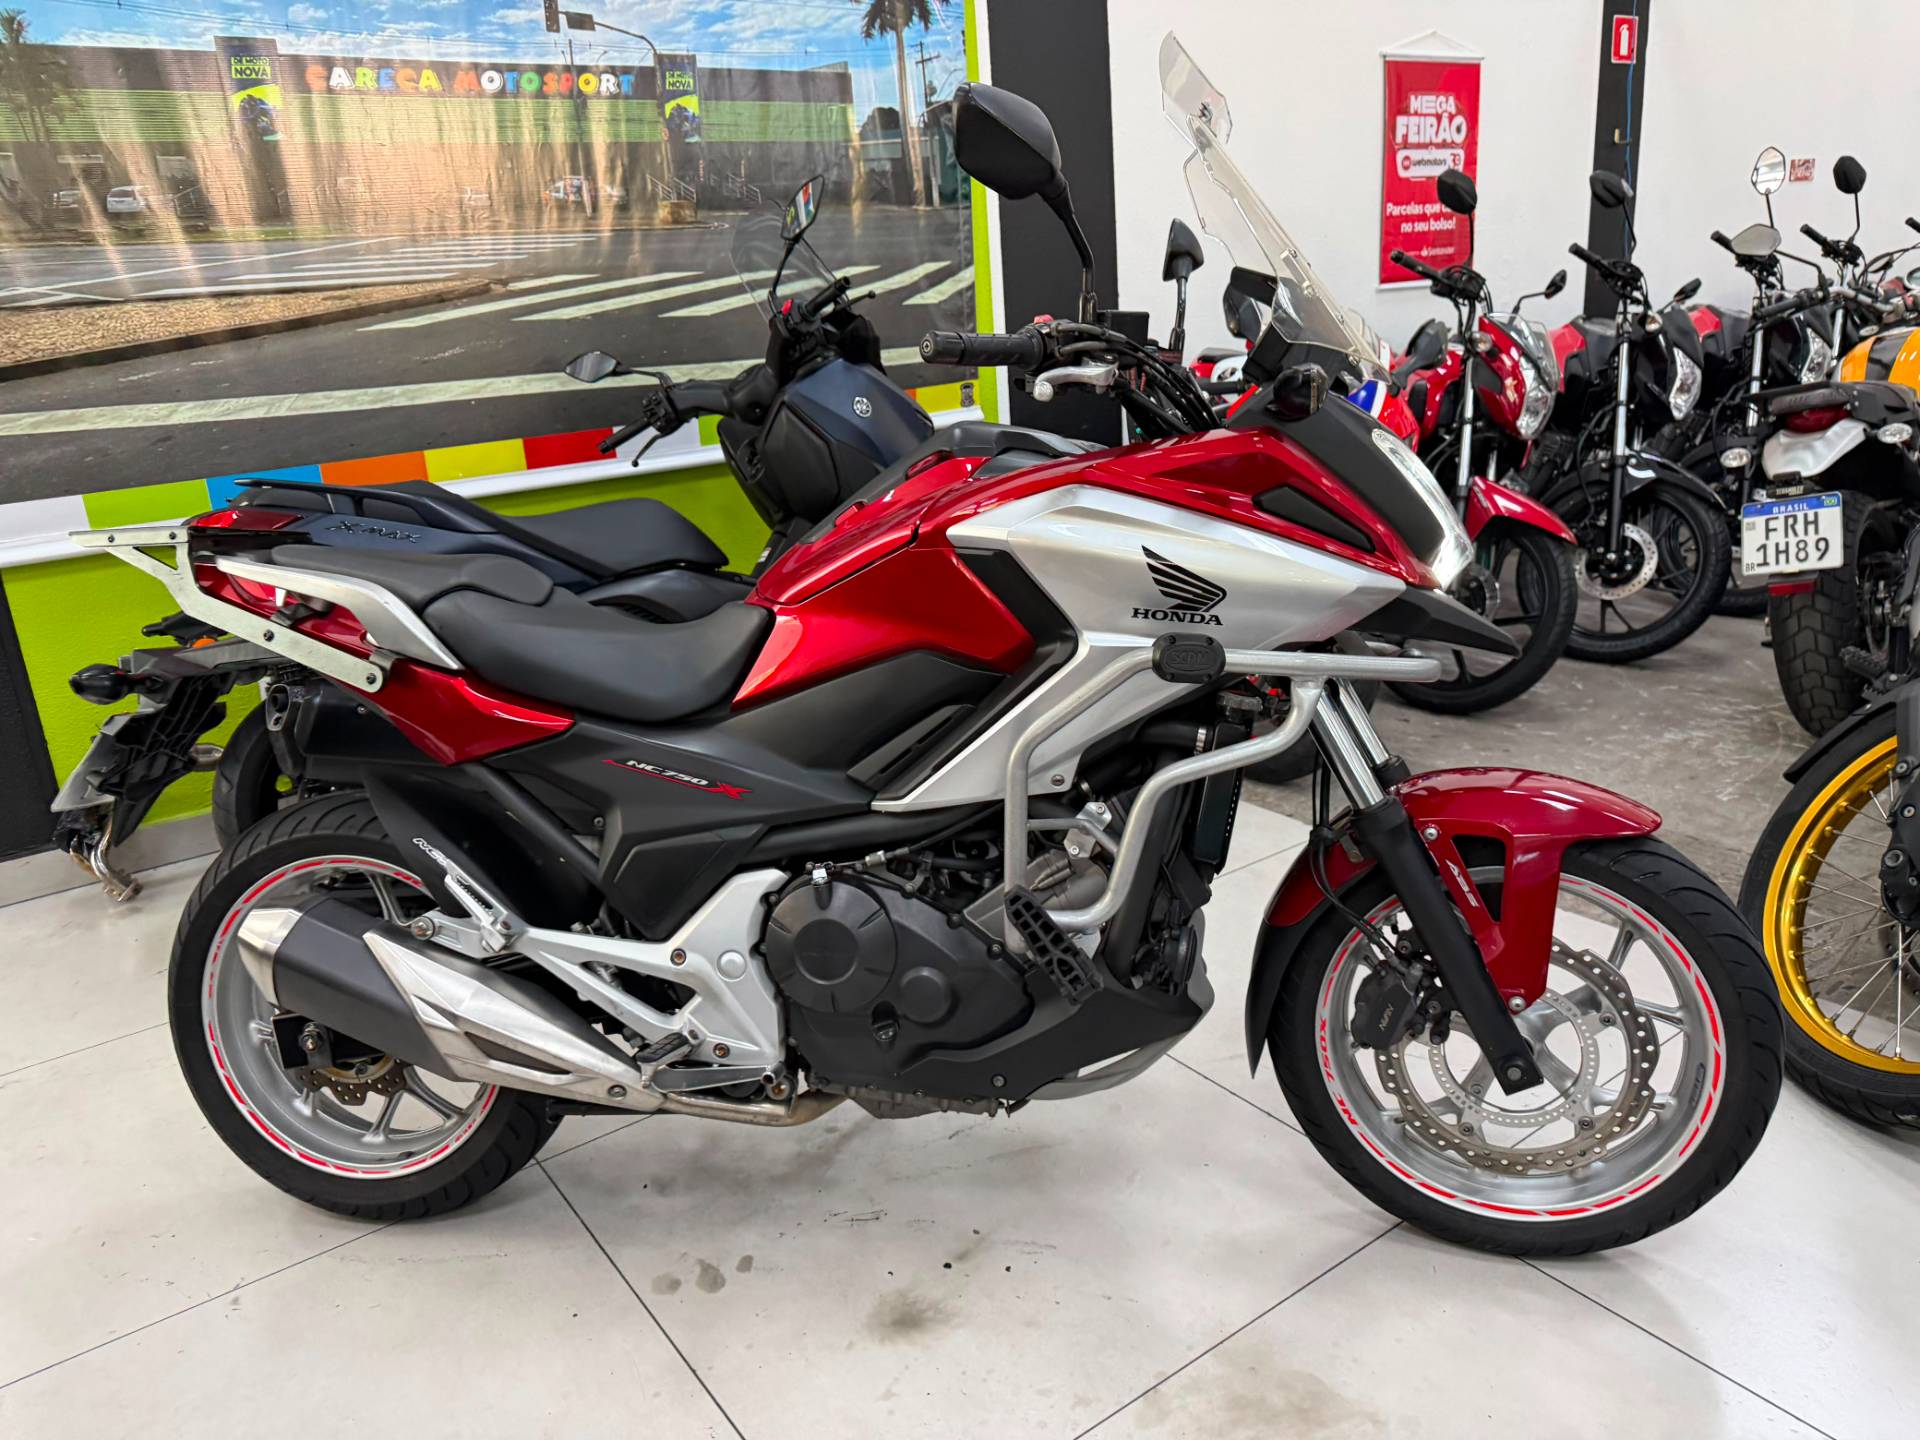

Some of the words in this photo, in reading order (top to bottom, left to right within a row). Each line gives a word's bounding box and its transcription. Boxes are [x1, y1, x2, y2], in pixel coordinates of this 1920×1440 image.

[234, 66, 269, 77] NOVA
[305, 63, 442, 92] CARECA
[453, 69, 636, 96] MOTOSPORT
[668, 80, 692, 90] NOVA
[1410, 95, 1456, 114] MEGA
[1395, 113, 1467, 144] FEIRÃO
[1386, 202, 1423, 216] Parcelas
[1424, 204, 1440, 216] que
[1401, 222, 1412, 233] no
[1414, 220, 1428, 231] seu
[1430, 217, 1456, 230] bolso!
[1773, 503, 1809, 514] BRASIL
[1764, 511, 1819, 541] FRH
[1756, 537, 1829, 567] 1H89
[1745, 562, 1756, 572] BR
[1131, 607, 1223, 626] HONDA
[1445, 859, 1480, 907] ABS
